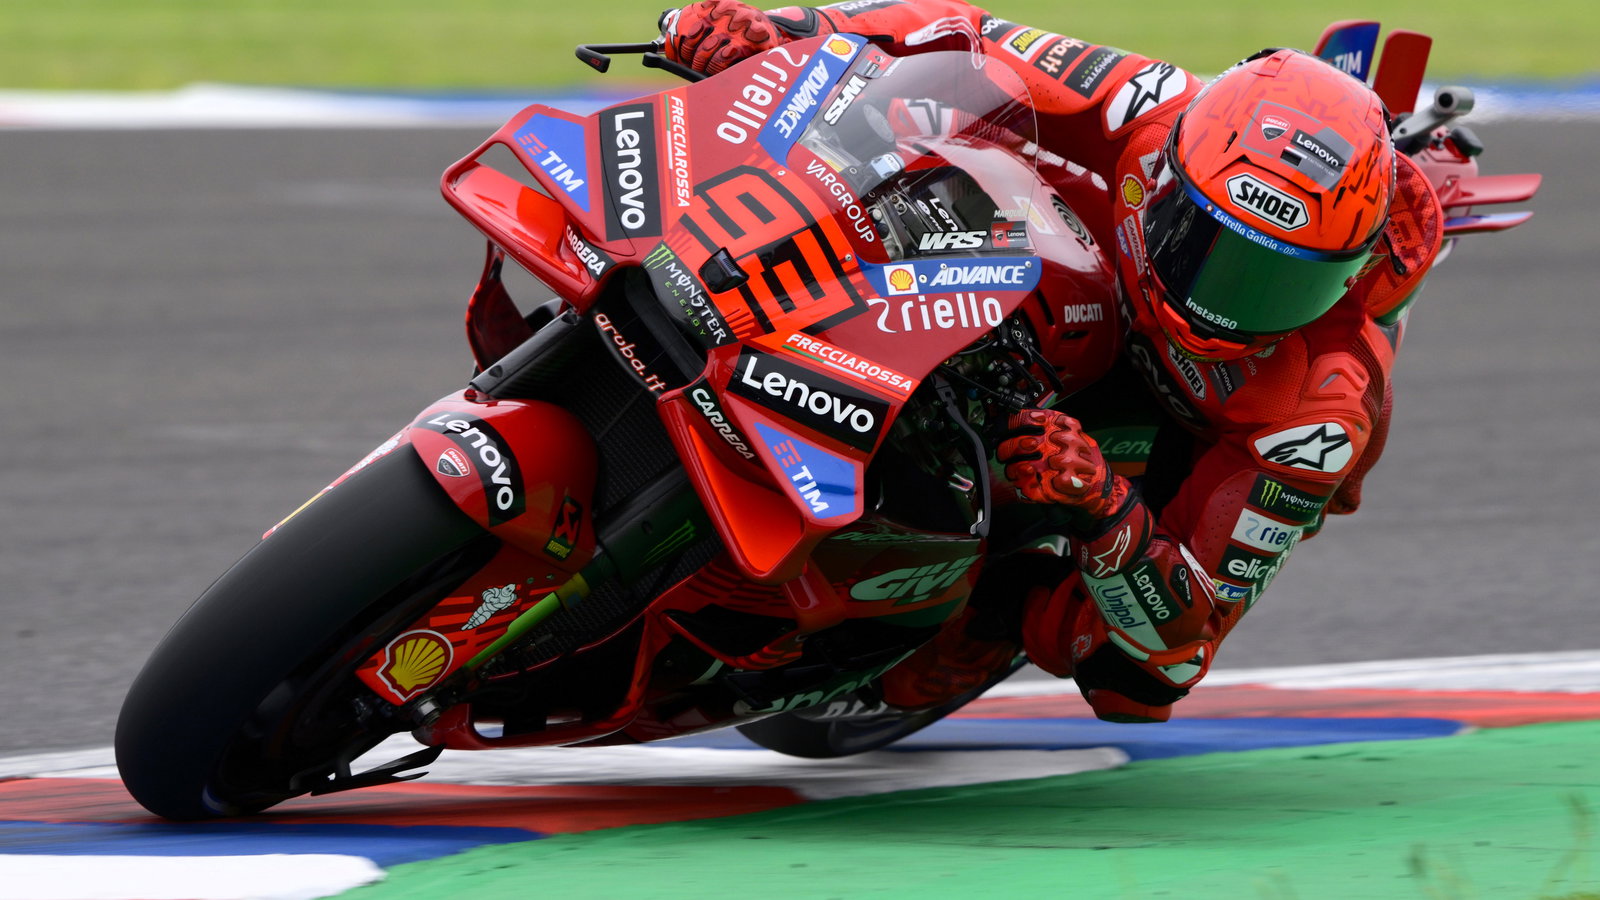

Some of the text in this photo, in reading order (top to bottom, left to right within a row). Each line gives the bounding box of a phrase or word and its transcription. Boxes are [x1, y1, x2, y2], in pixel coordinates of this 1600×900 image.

[1334, 50, 1362, 75] TIM
[716, 60, 788, 145] riello
[774, 58, 830, 139] ADVANCE
[823, 73, 868, 127] WRS
[1264, 116, 1290, 129] DUCATI
[540, 150, 585, 193] TIM
[614, 111, 646, 230] Lenovo
[670, 95, 691, 208] FRECCIAROSSA
[1296, 133, 1339, 167] Lenovo
[805, 159, 875, 244] VARGROUP
[1235, 181, 1301, 226] SHOEI
[566, 225, 607, 276] CARRERA
[918, 230, 988, 251] WRS
[1213, 208, 1246, 236] Estrella
[1246, 229, 1278, 251] Galicia
[930, 265, 1026, 287] ADVANCE
[665, 262, 727, 345] MONSTER
[901, 292, 1003, 332] riello
[1064, 303, 1104, 324] DUCATI
[1185, 296, 1238, 331] Insta360
[786, 333, 913, 392] FRECCIAROSSA
[1171, 348, 1205, 395] SHOEI
[1218, 361, 1233, 392] Lenovo
[741, 356, 875, 433] Lenovo
[691, 388, 755, 460] CARRERA
[427, 414, 514, 511] Lenovo
[448, 450, 468, 473] DUCATI
[792, 465, 829, 514] TIM
[850, 553, 983, 603] GIVI
[1132, 564, 1170, 620] Lenovo
[1102, 585, 1147, 629] Unipol
